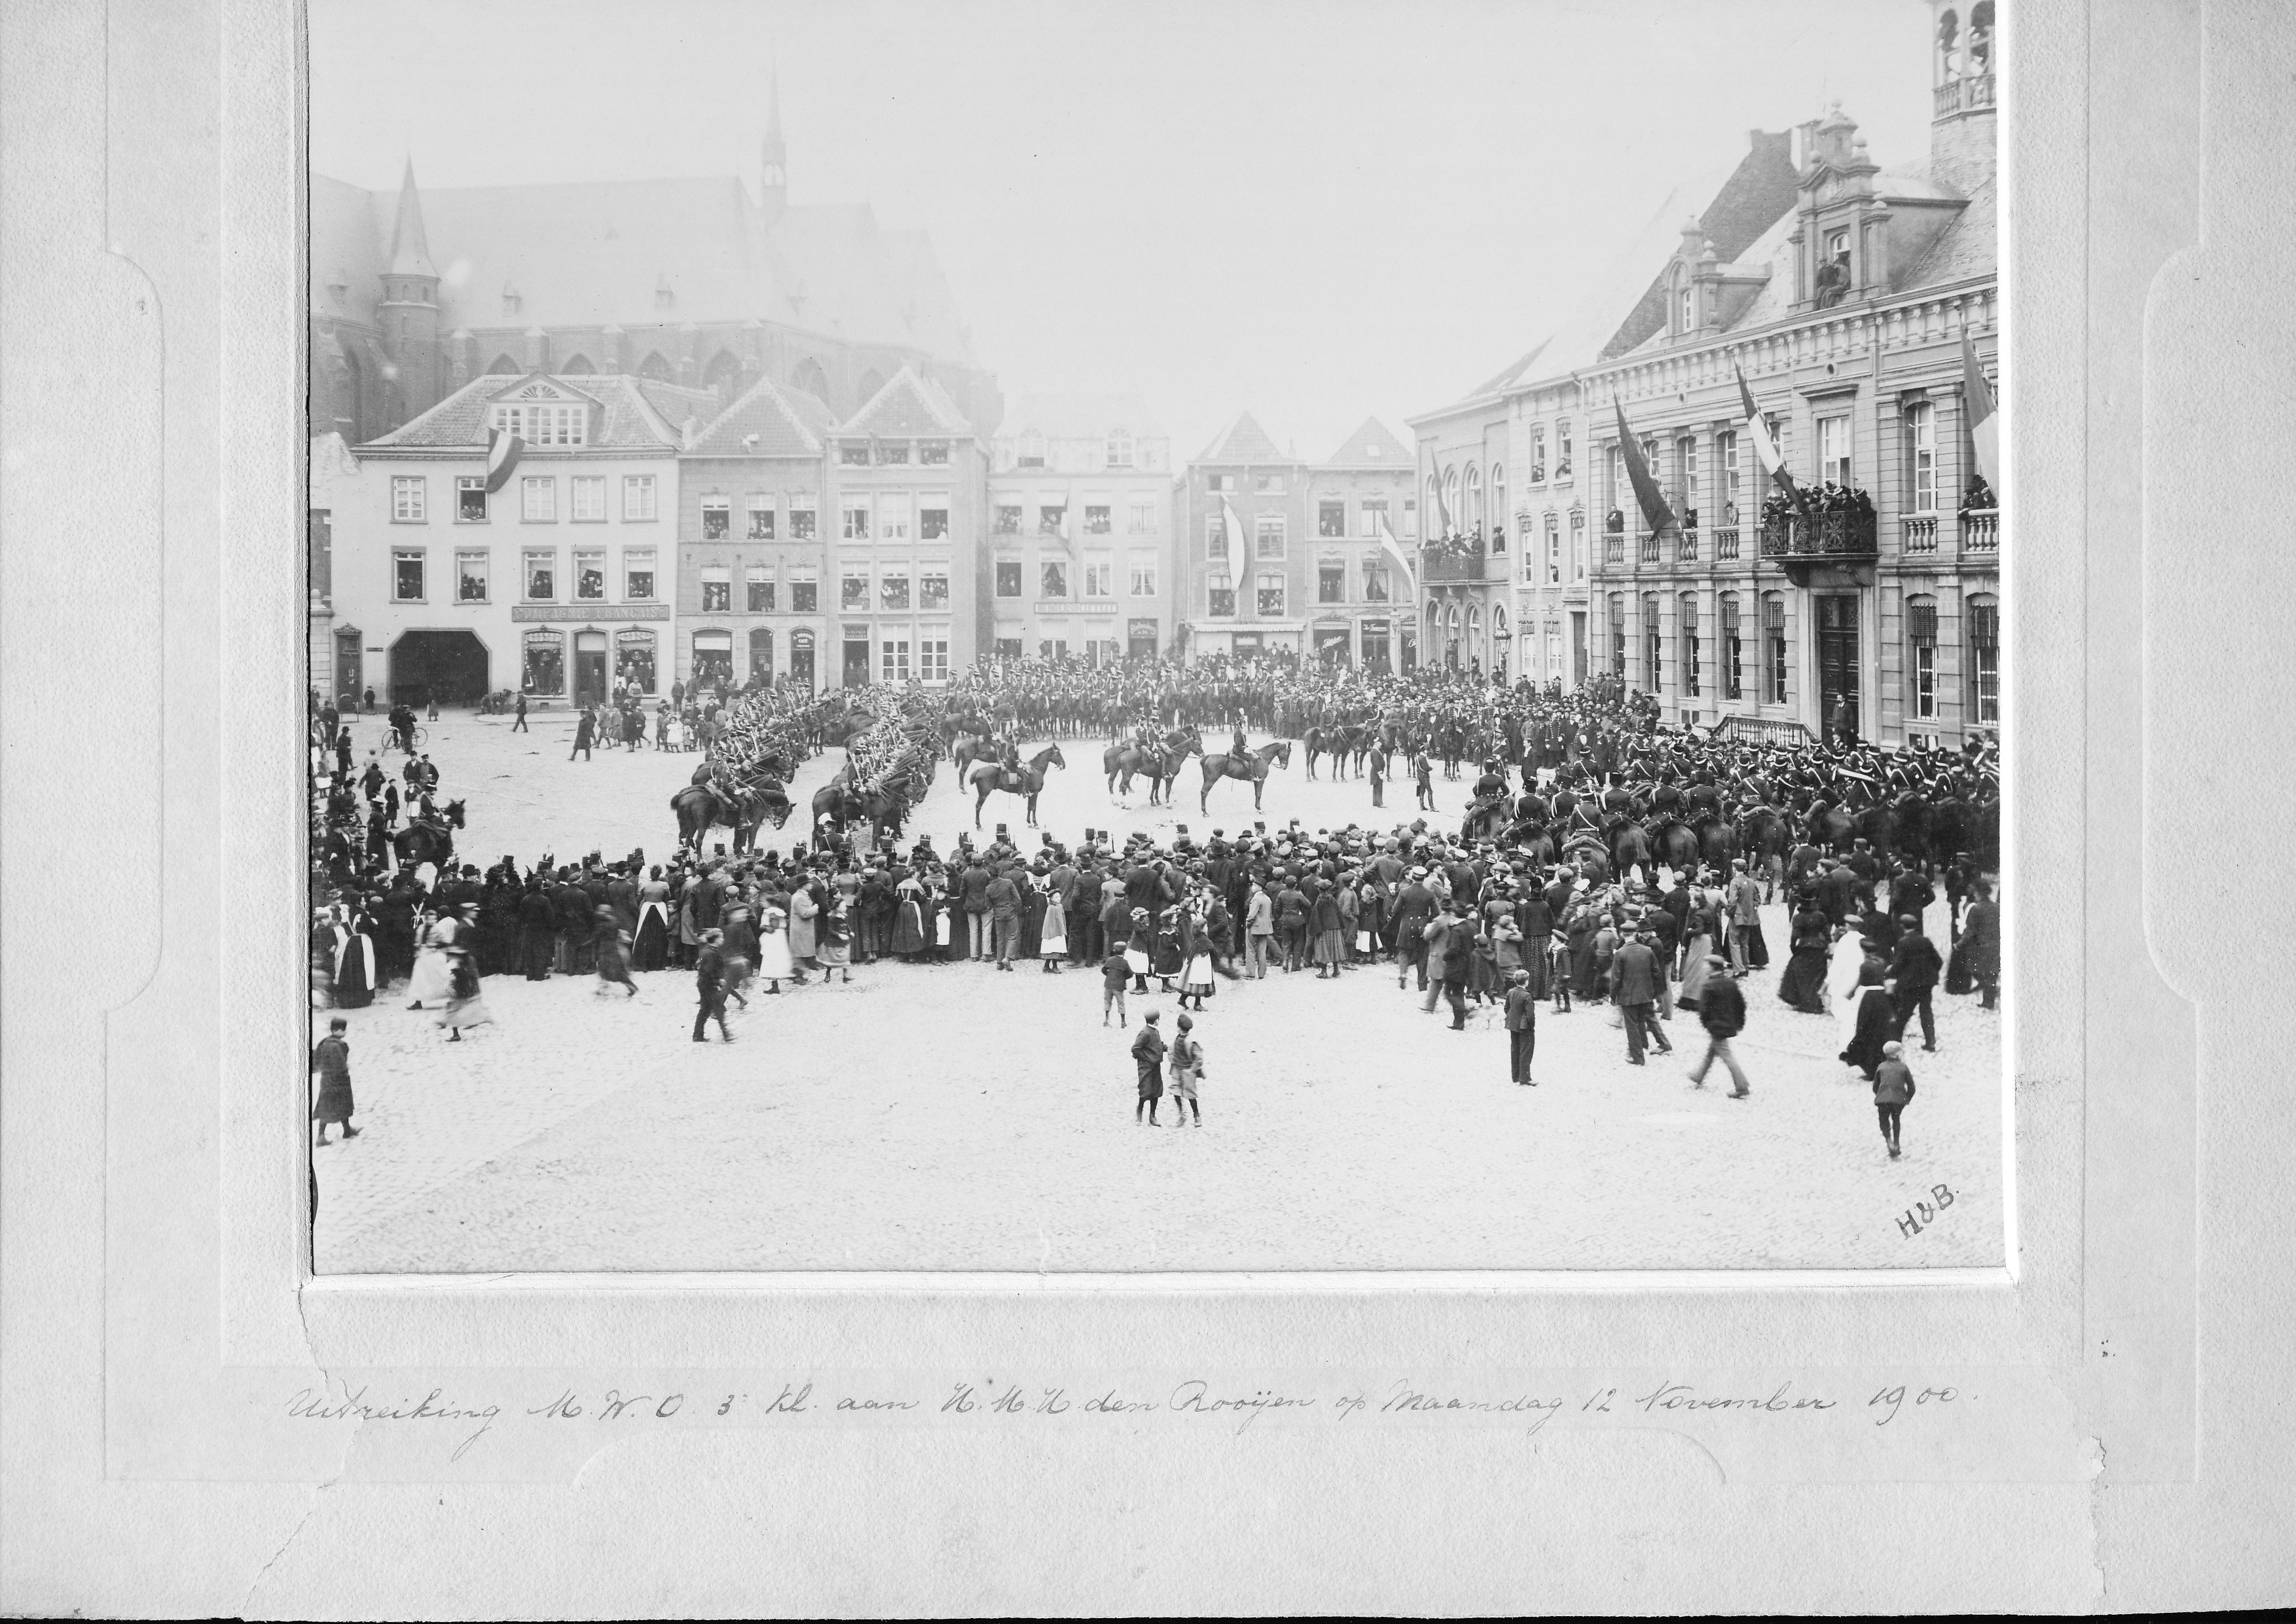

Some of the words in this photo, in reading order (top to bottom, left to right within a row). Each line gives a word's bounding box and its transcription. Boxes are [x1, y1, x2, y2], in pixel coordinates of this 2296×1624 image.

[515, 608, 589, 619] COMPAGNIE
[285, 1385, 501, 1463] Uitreiking
[837, 1397, 920, 1412] aan
[1084, 1389, 1159, 1413] den
[1336, 1392, 1366, 1421] op
[1380, 1378, 1563, 1437] Maandag
[1582, 1388, 1616, 1412] 12
[1635, 1379, 1837, 1412] November
